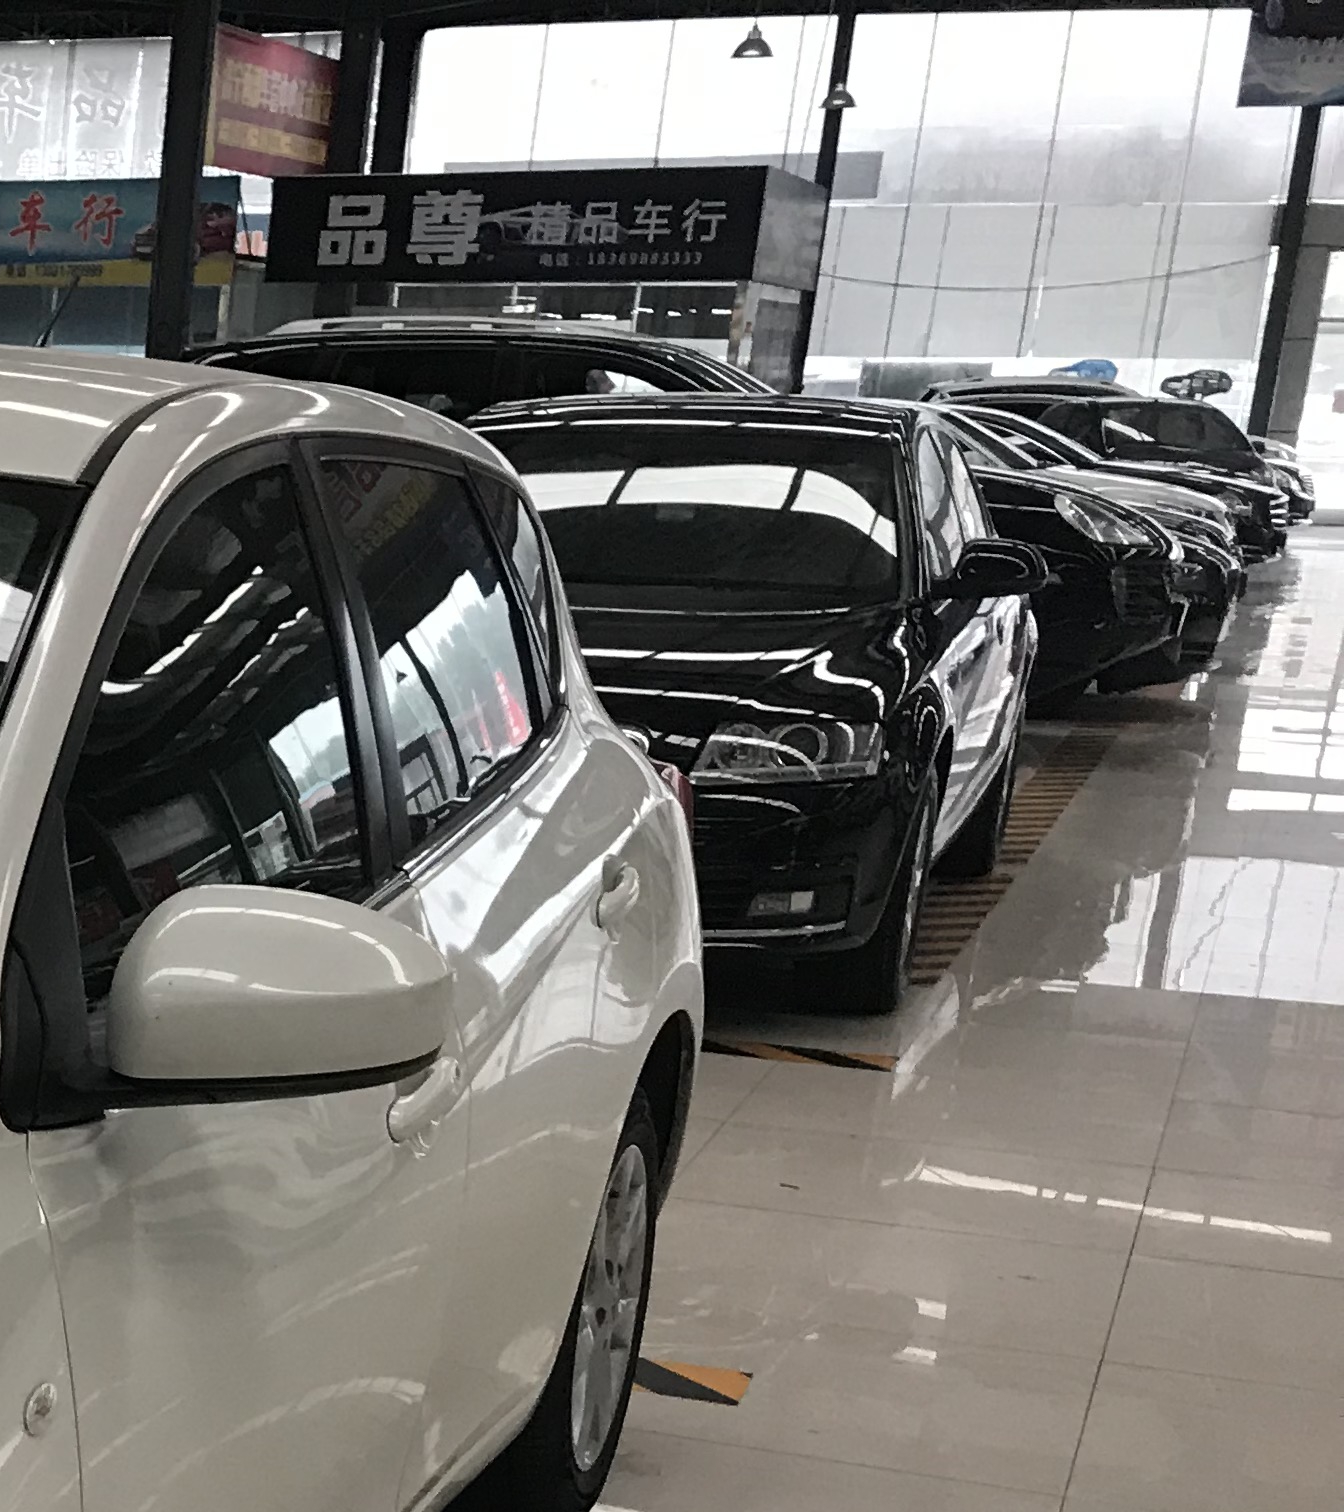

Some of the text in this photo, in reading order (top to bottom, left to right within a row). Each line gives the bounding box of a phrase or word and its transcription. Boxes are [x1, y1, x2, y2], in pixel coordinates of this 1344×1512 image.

[316, 188, 484, 267] 品尊
[525, 199, 728, 244] 精品车行
